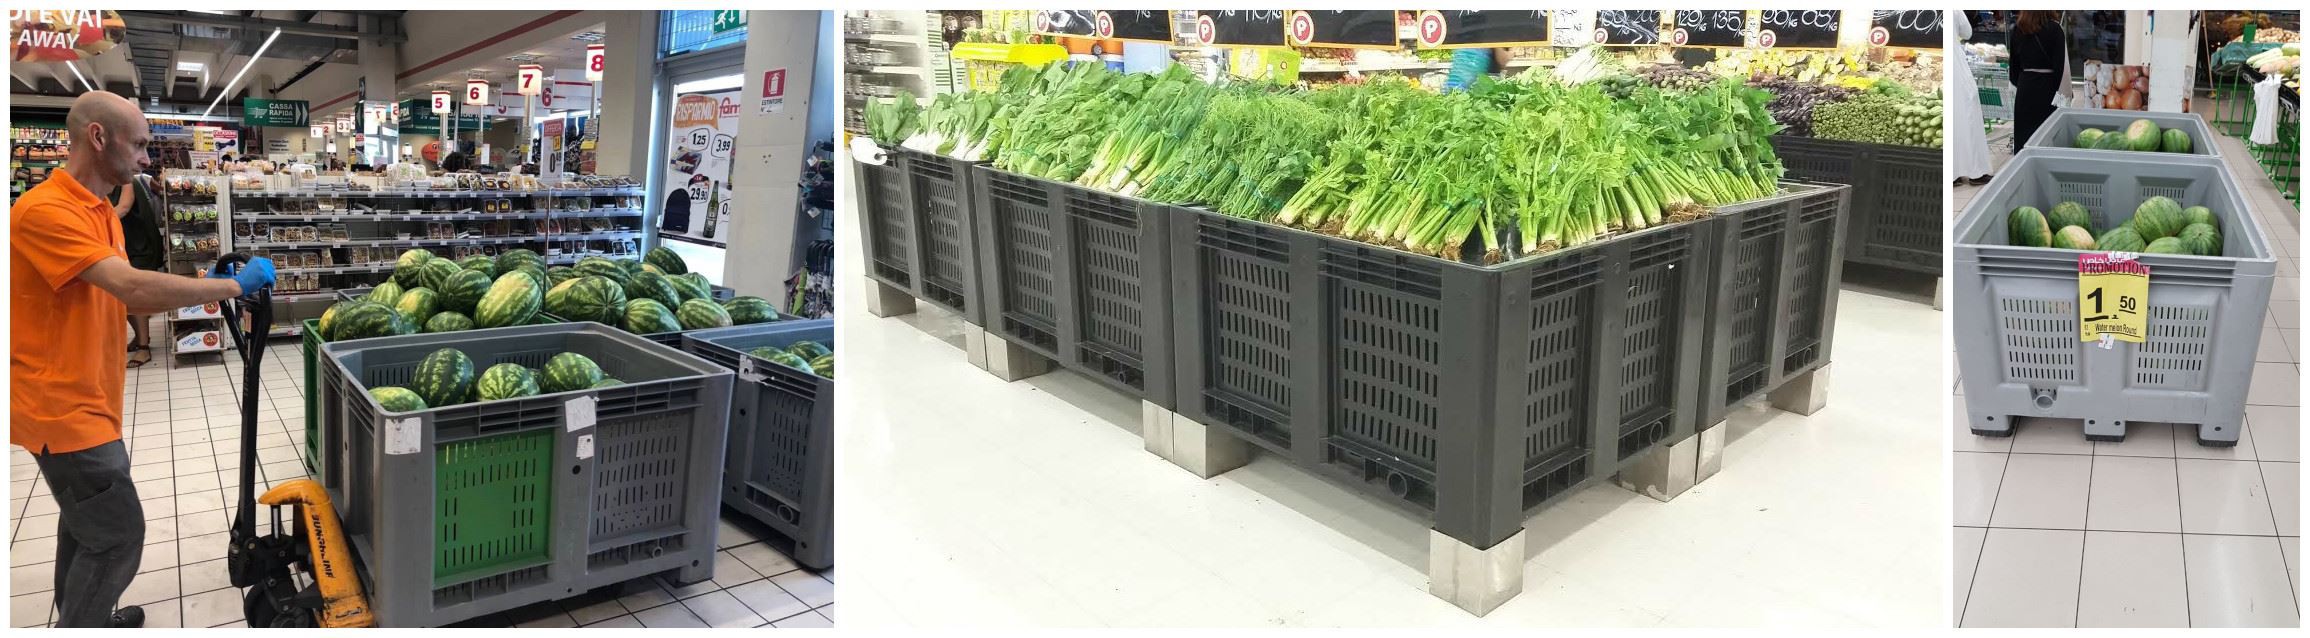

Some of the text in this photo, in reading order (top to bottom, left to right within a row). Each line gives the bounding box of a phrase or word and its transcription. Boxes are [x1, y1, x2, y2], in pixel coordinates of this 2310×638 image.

[17, 29, 80, 49] AWAY
[591, 54, 604, 72] 8
[522, 74, 533, 88] 7
[469, 87, 480, 100] 6
[434, 97, 443, 109] 5
[268, 109, 294, 117] RAPIDA
[323, 126, 329, 134] 2
[2081, 261, 2147, 275] PROMOTION
[2087, 287, 2136, 314] 1 50
[2095, 323, 2108, 332] Water
[2122, 324, 2137, 335] Round
